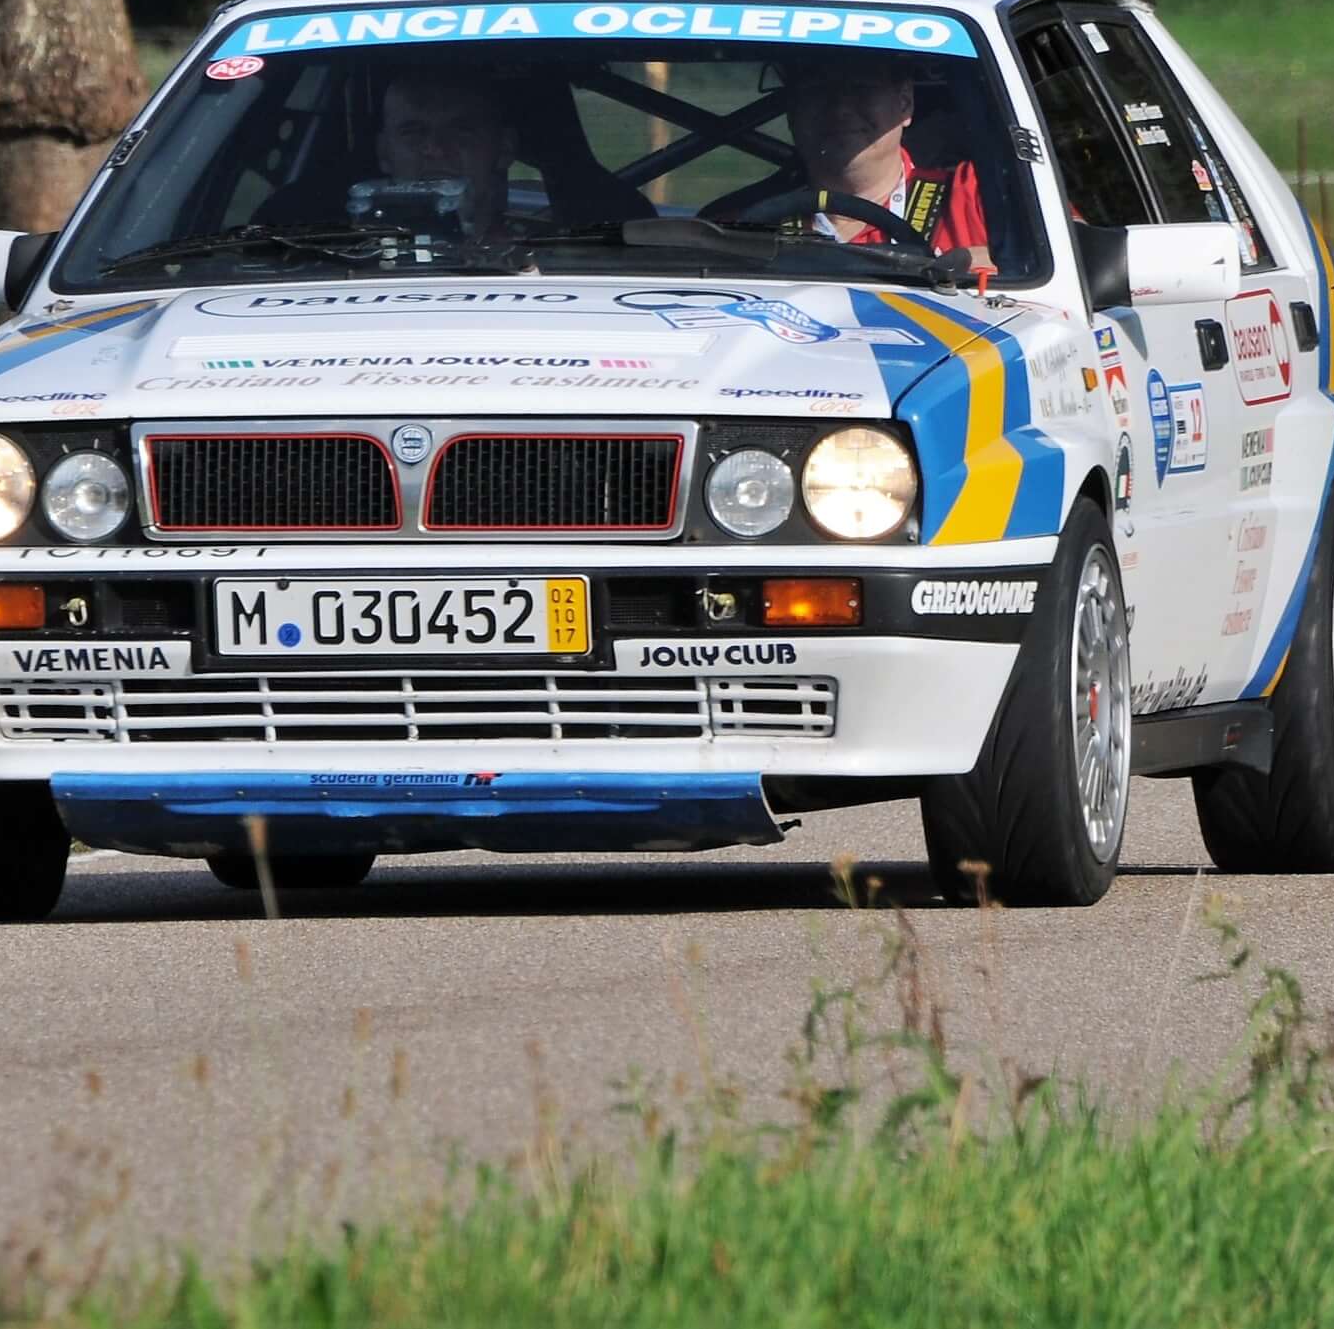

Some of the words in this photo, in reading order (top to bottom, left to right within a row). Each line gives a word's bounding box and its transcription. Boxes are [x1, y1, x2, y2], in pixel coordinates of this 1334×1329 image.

[243, 7, 540, 52] LANCIA
[573, 5, 952, 48] OCLEPPO
[248, 292, 579, 309] bausano
[424, 356, 511, 367] JOLLY
[512, 356, 591, 368] CLUB
[135, 373, 323, 393] Cristiano
[340, 372, 490, 388] Fissore
[510, 373, 701, 391] cashmere
[718, 386, 864, 401] speedline
[551, 588, 574, 604] 02
[911, 579, 1039, 615] GRECOGOMME
[230, 591, 267, 645] M
[312, 589, 536, 645] 030452
[553, 608, 574, 624] 10
[554, 628, 576, 643] 17
[640, 645, 720, 667] JOLLY
[724, 642, 797, 665] CLUB
[310, 773, 377, 784] scuderia
[382, 773, 459, 786] germania
